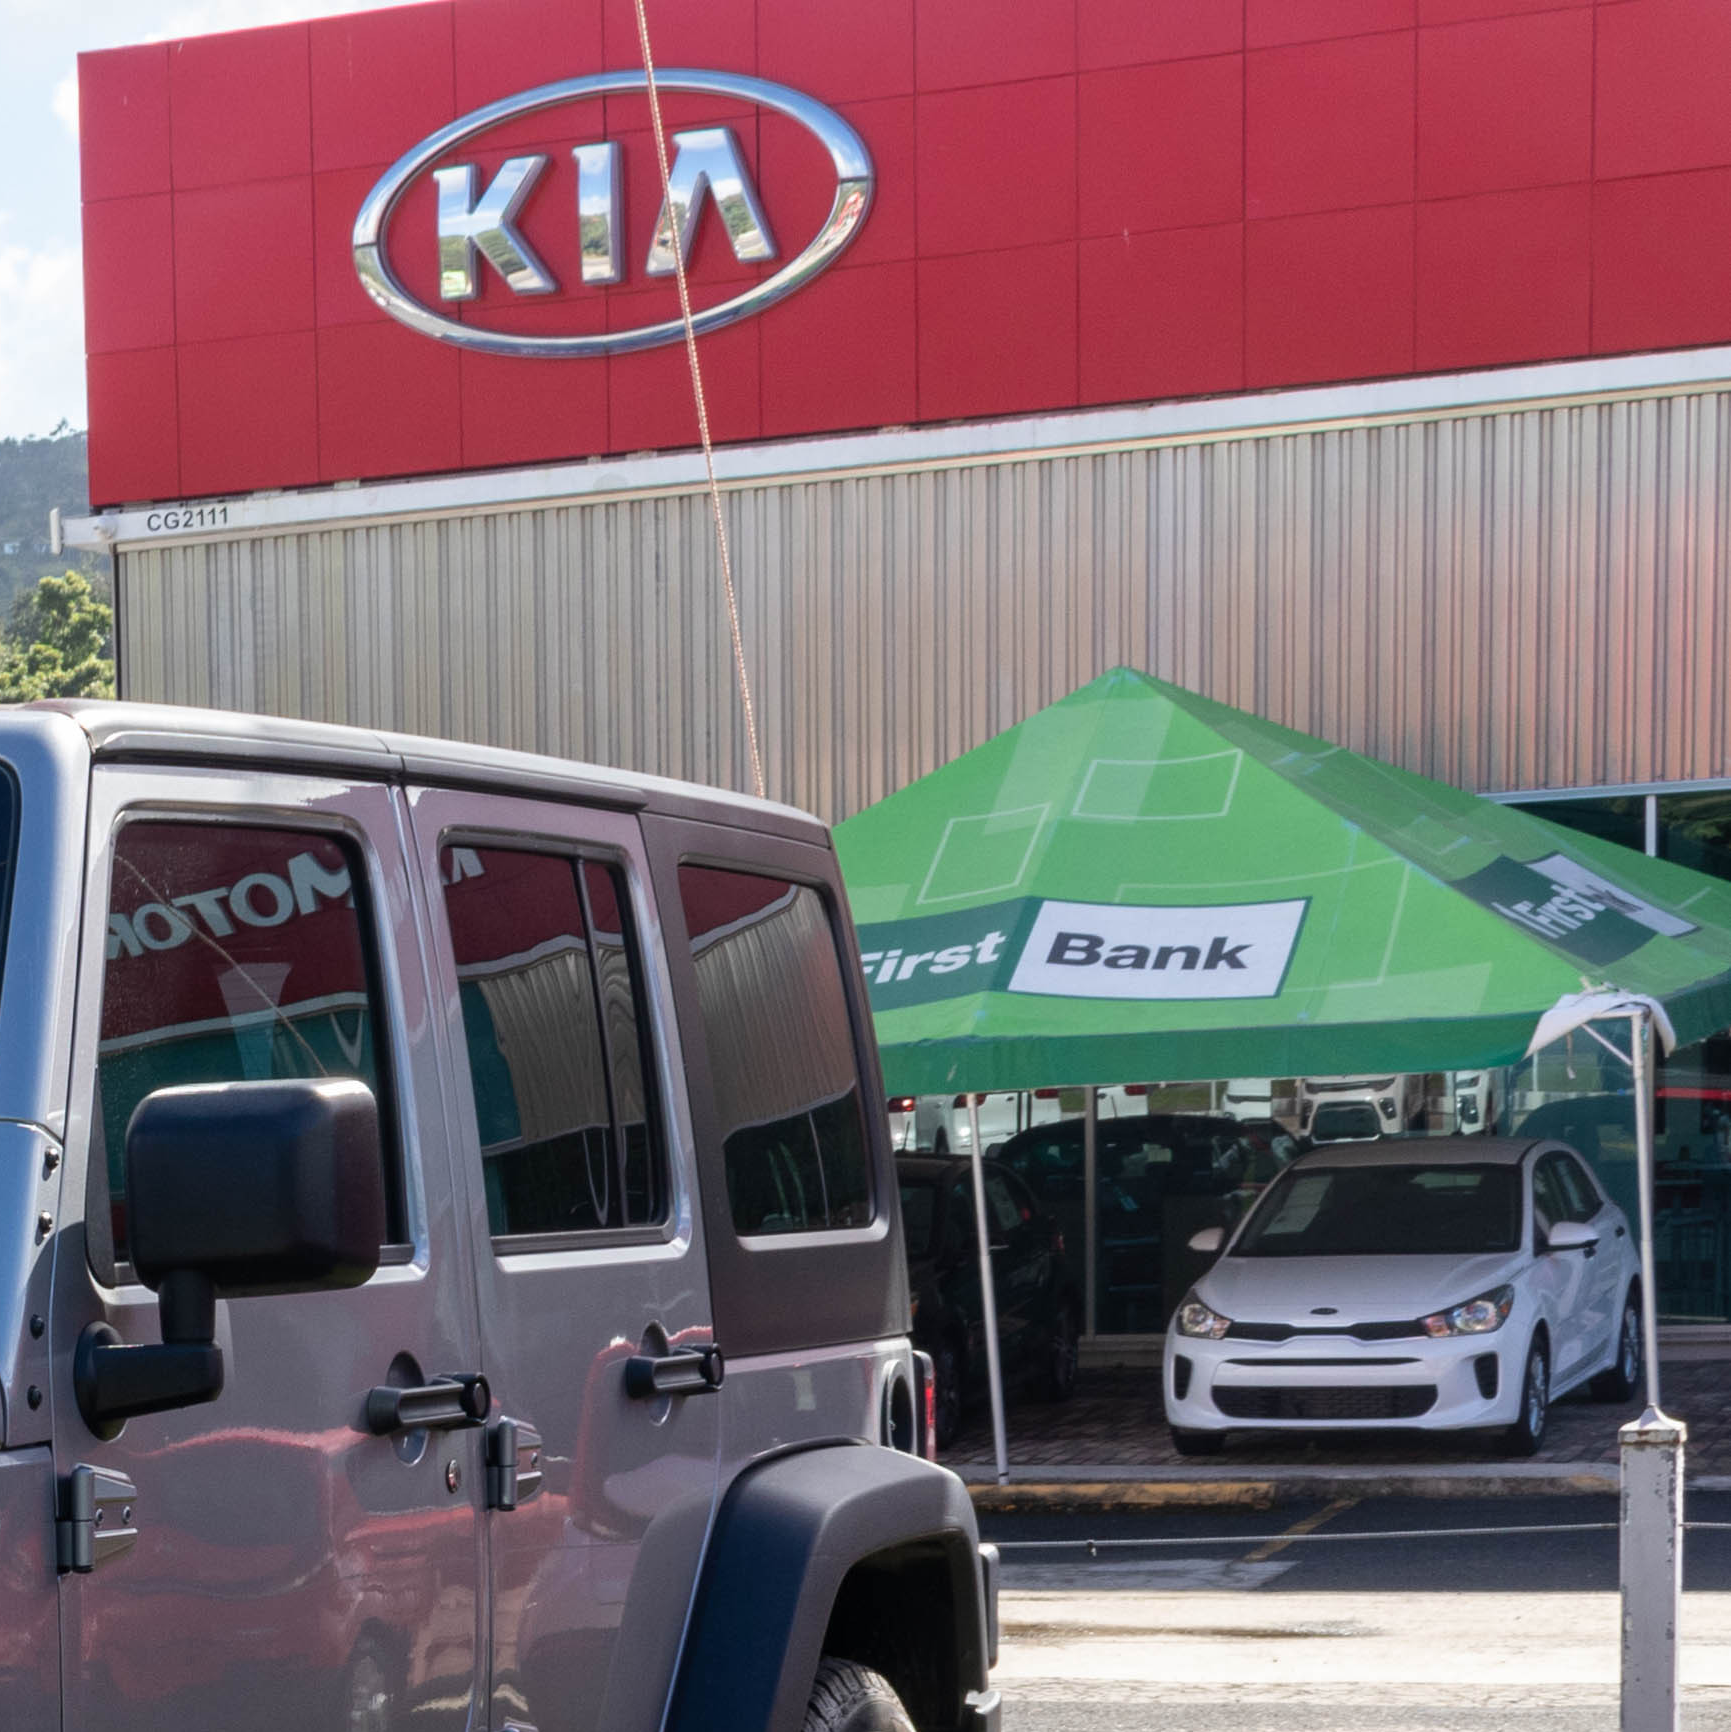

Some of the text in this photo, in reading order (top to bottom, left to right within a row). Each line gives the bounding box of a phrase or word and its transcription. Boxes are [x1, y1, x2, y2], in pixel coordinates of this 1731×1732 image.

[432, 125, 779, 301] KIA
[147, 505, 229, 532] CG2111
[1045, 931, 1254, 971] Bank
